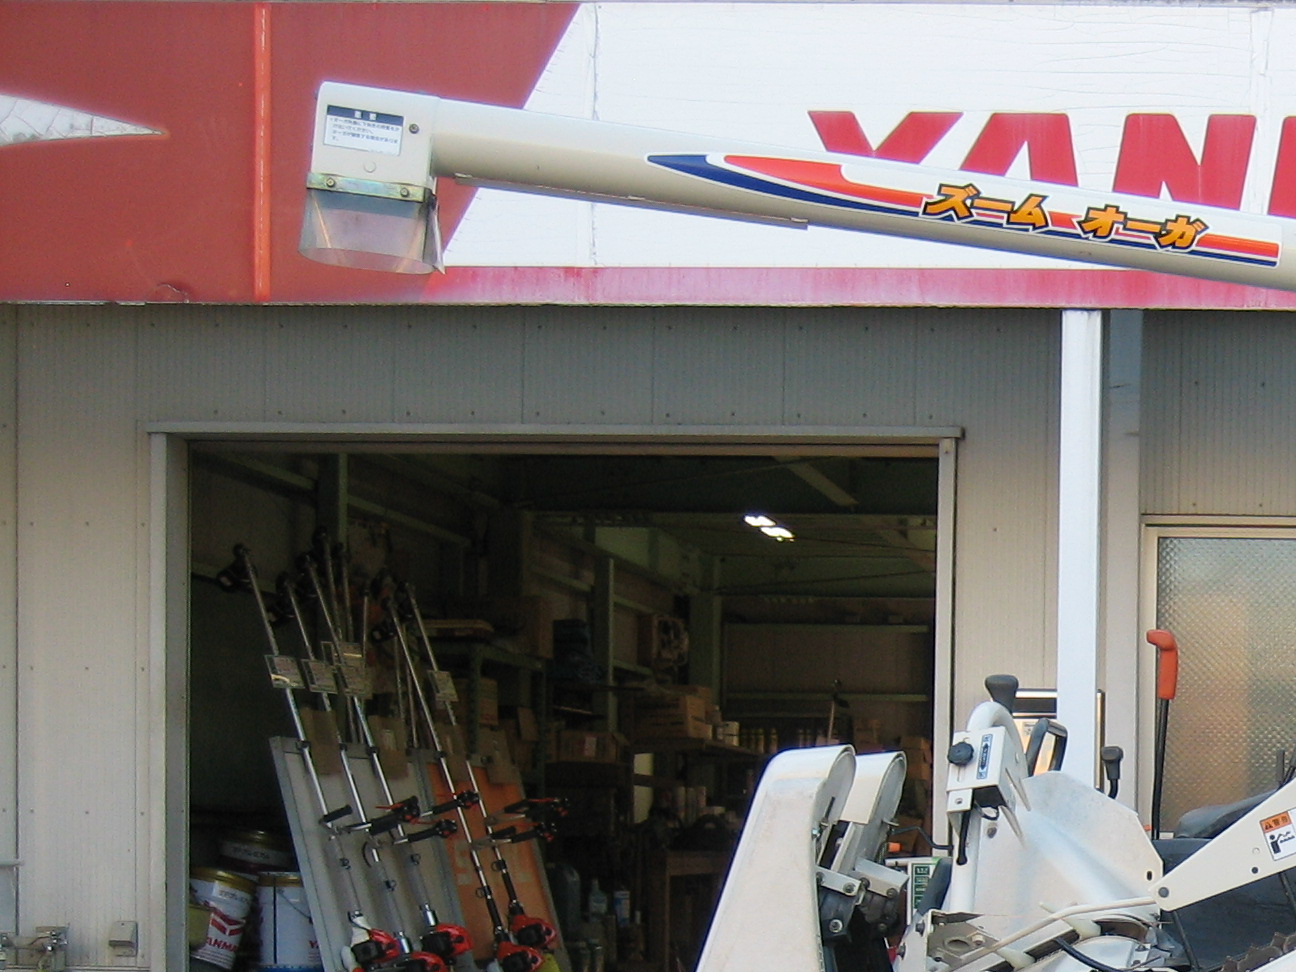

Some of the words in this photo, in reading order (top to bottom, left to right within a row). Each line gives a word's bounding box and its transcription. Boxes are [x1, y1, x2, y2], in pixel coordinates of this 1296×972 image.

[922, 183, 1049, 230] ズーム
[1080, 204, 1209, 250] オーガ
